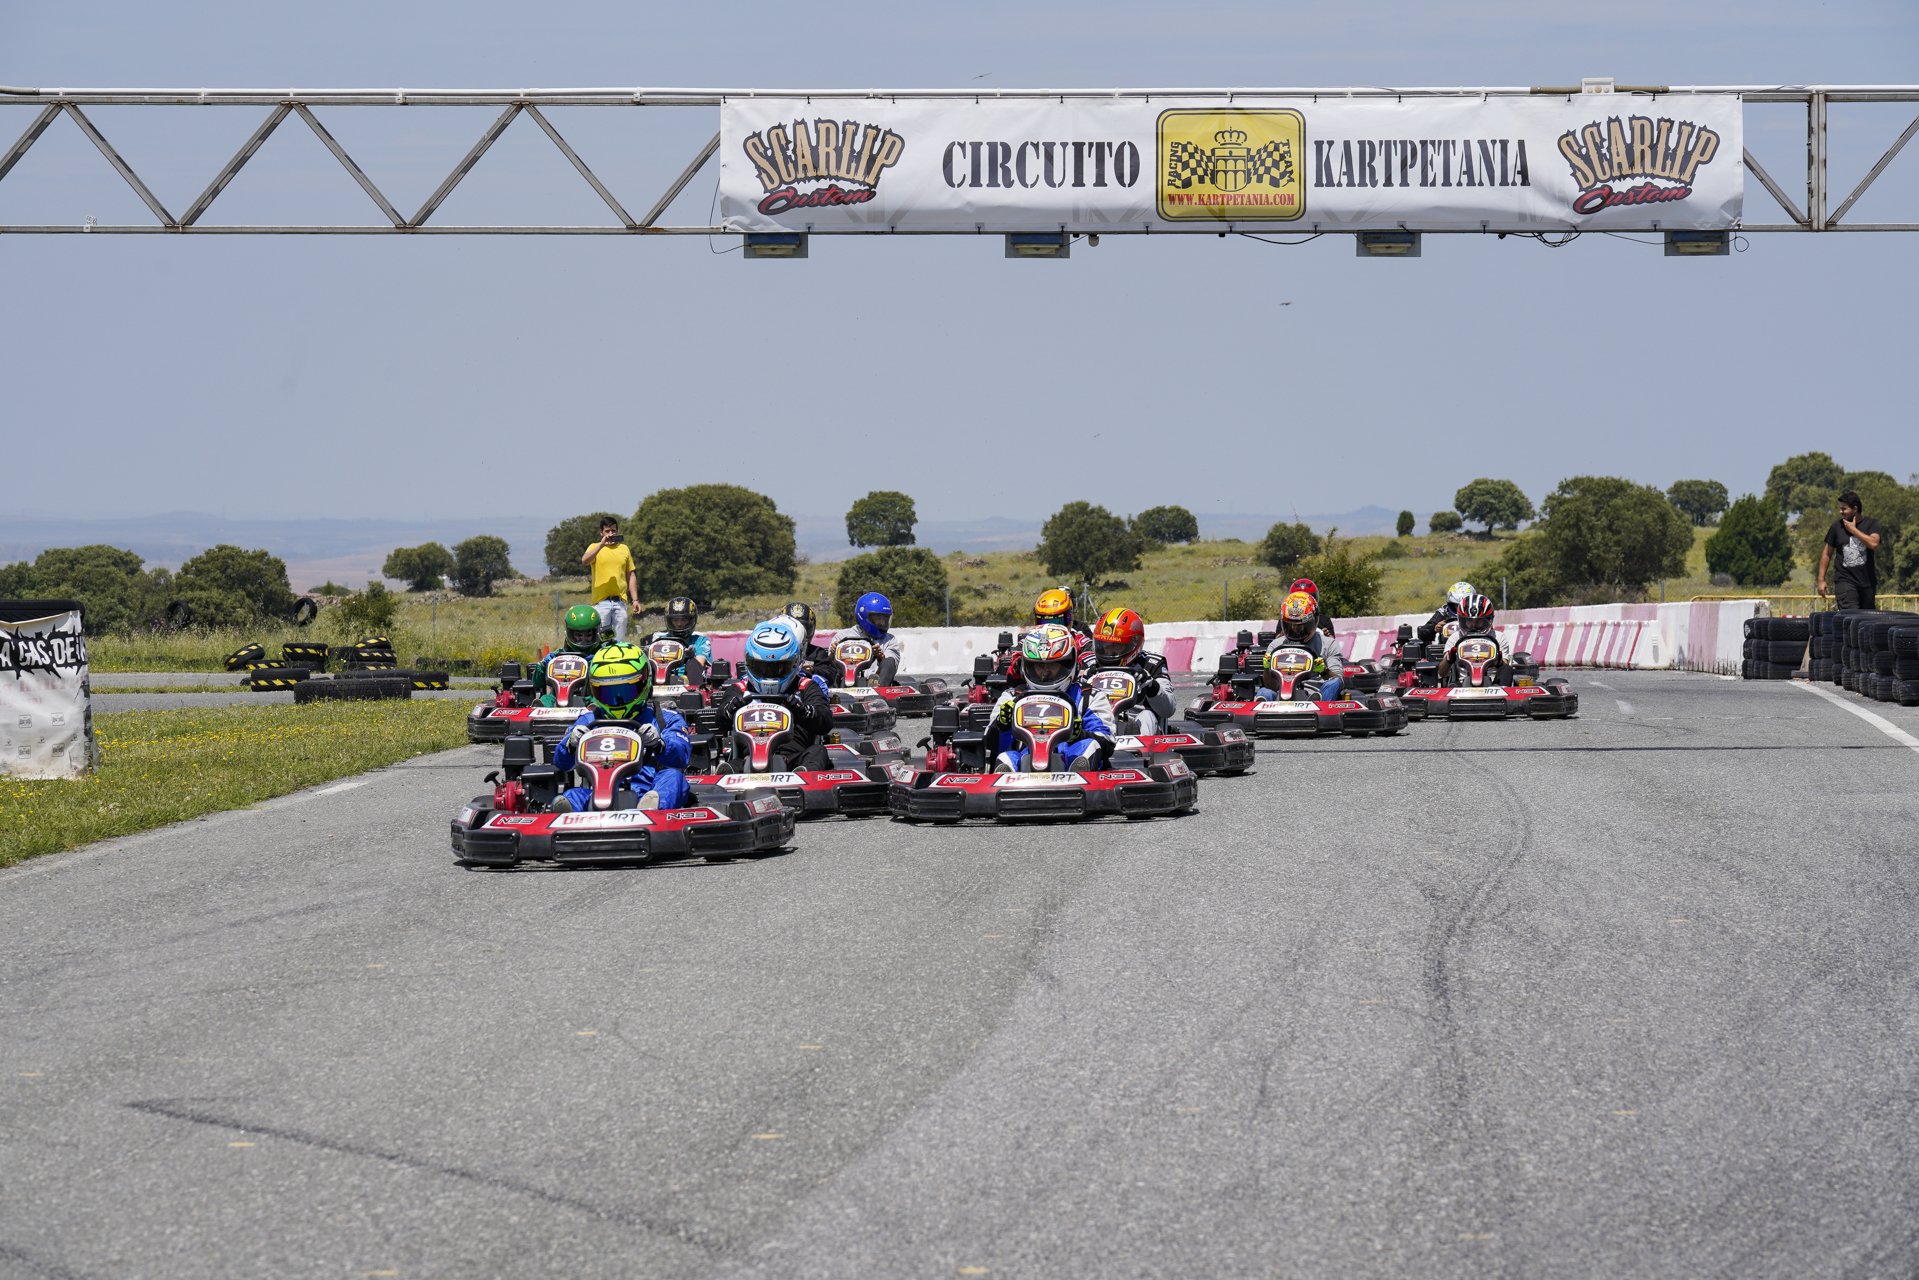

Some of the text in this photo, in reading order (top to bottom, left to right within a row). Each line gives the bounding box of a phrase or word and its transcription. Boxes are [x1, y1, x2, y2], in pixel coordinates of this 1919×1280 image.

[744, 119, 904, 192] SCARLIP
[1558, 116, 1719, 191] SCARLIP
[942, 140, 1140, 188] CIRCUITO
[1167, 141, 1181, 189] RACING
[1281, 138, 1295, 188] TEAM
[1313, 139, 1531, 188] KARTPETANIA
[758, 184, 876, 214] Custom
[1167, 193, 1295, 206] WWW.KARTPETANIA.COM
[1573, 182, 1692, 213] Custom
[660, 645, 671, 653] 6
[845, 646, 863, 654] 10
[1471, 644, 1481, 653] 3
[559, 661, 576, 670] 11
[1285, 654, 1297, 664] 4
[1099, 678, 1123, 689] 15
[750, 710, 777, 722] 18
[1035, 704, 1051, 717] 7
[599, 737, 616, 751] 8
